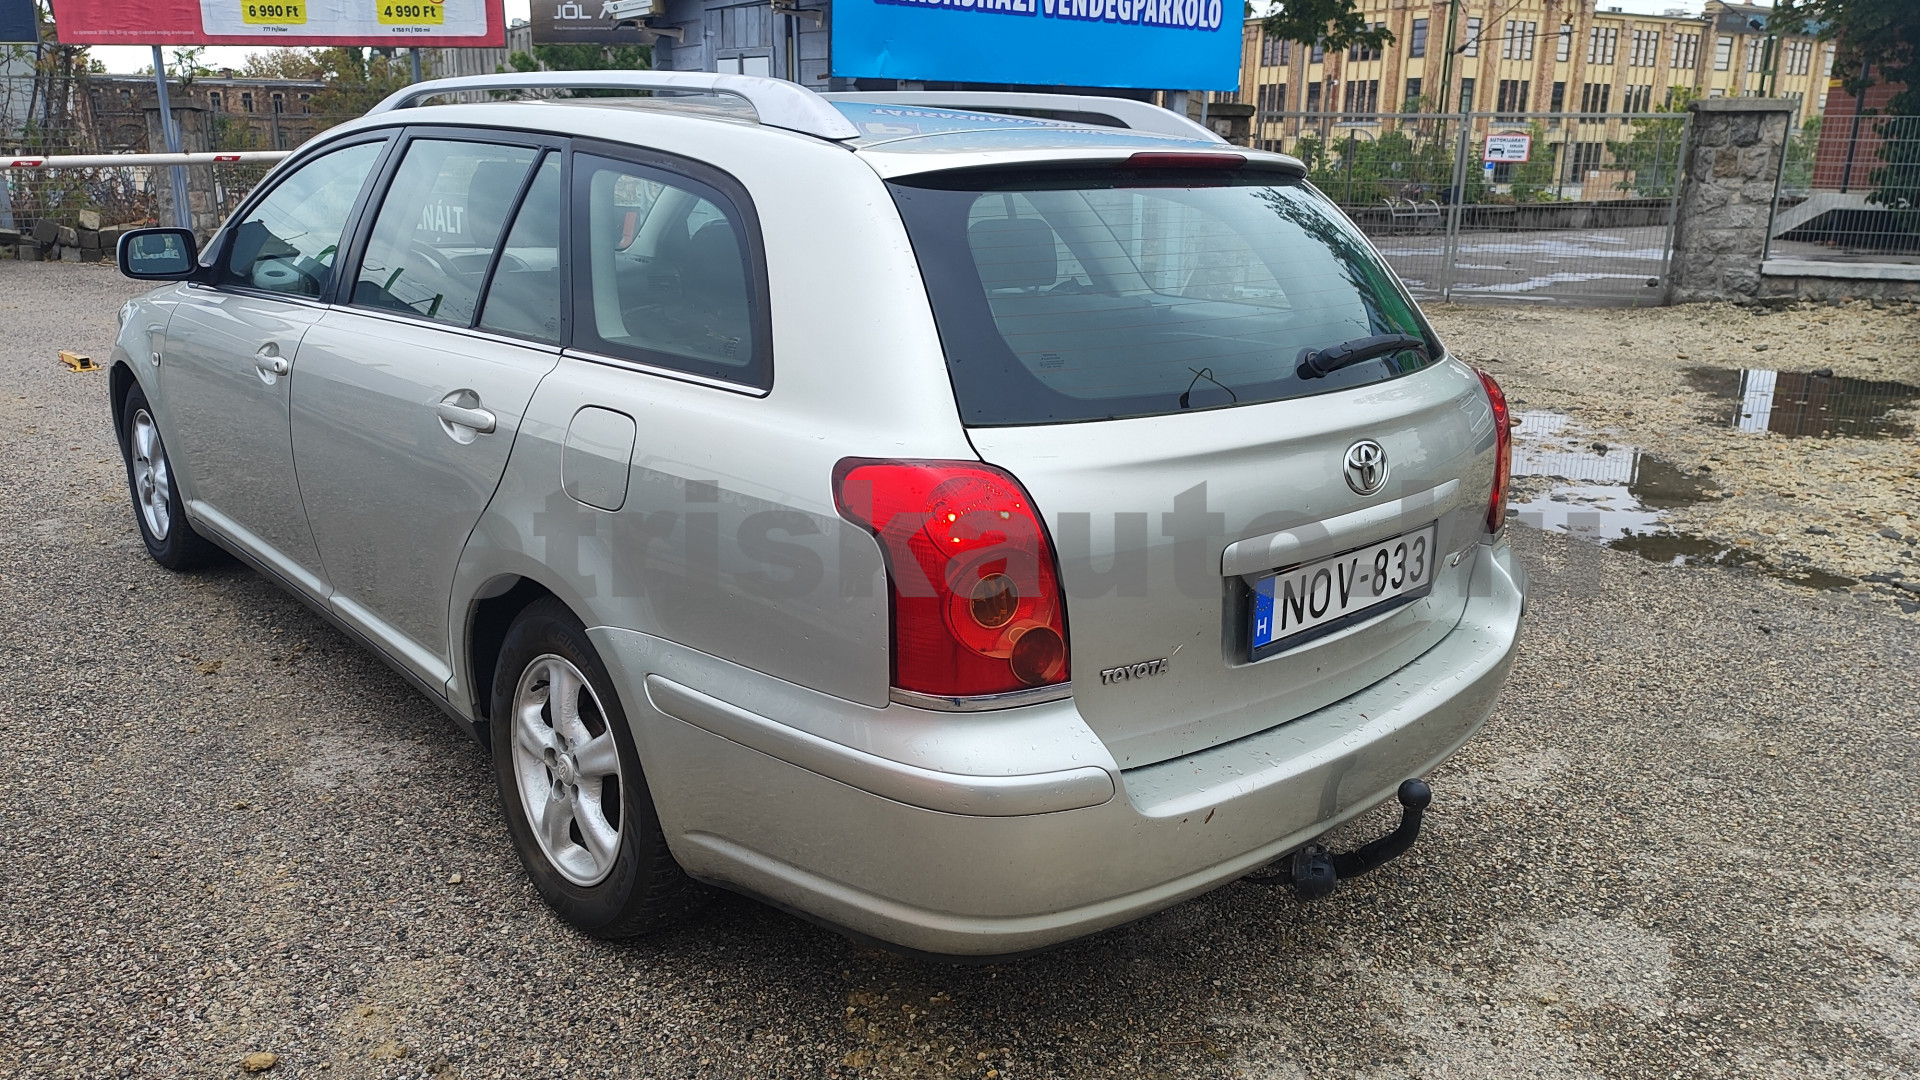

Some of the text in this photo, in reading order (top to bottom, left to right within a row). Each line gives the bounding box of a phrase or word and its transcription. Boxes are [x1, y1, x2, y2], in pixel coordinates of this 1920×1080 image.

[248, 5, 299, 17] 6 990 Ft
[384, 5, 436, 17] 4 990 Ft
[1281, 535, 1426, 631] NOV-833
[1256, 616, 1268, 637] H
[1101, 658, 1169, 685] TOYOTA
